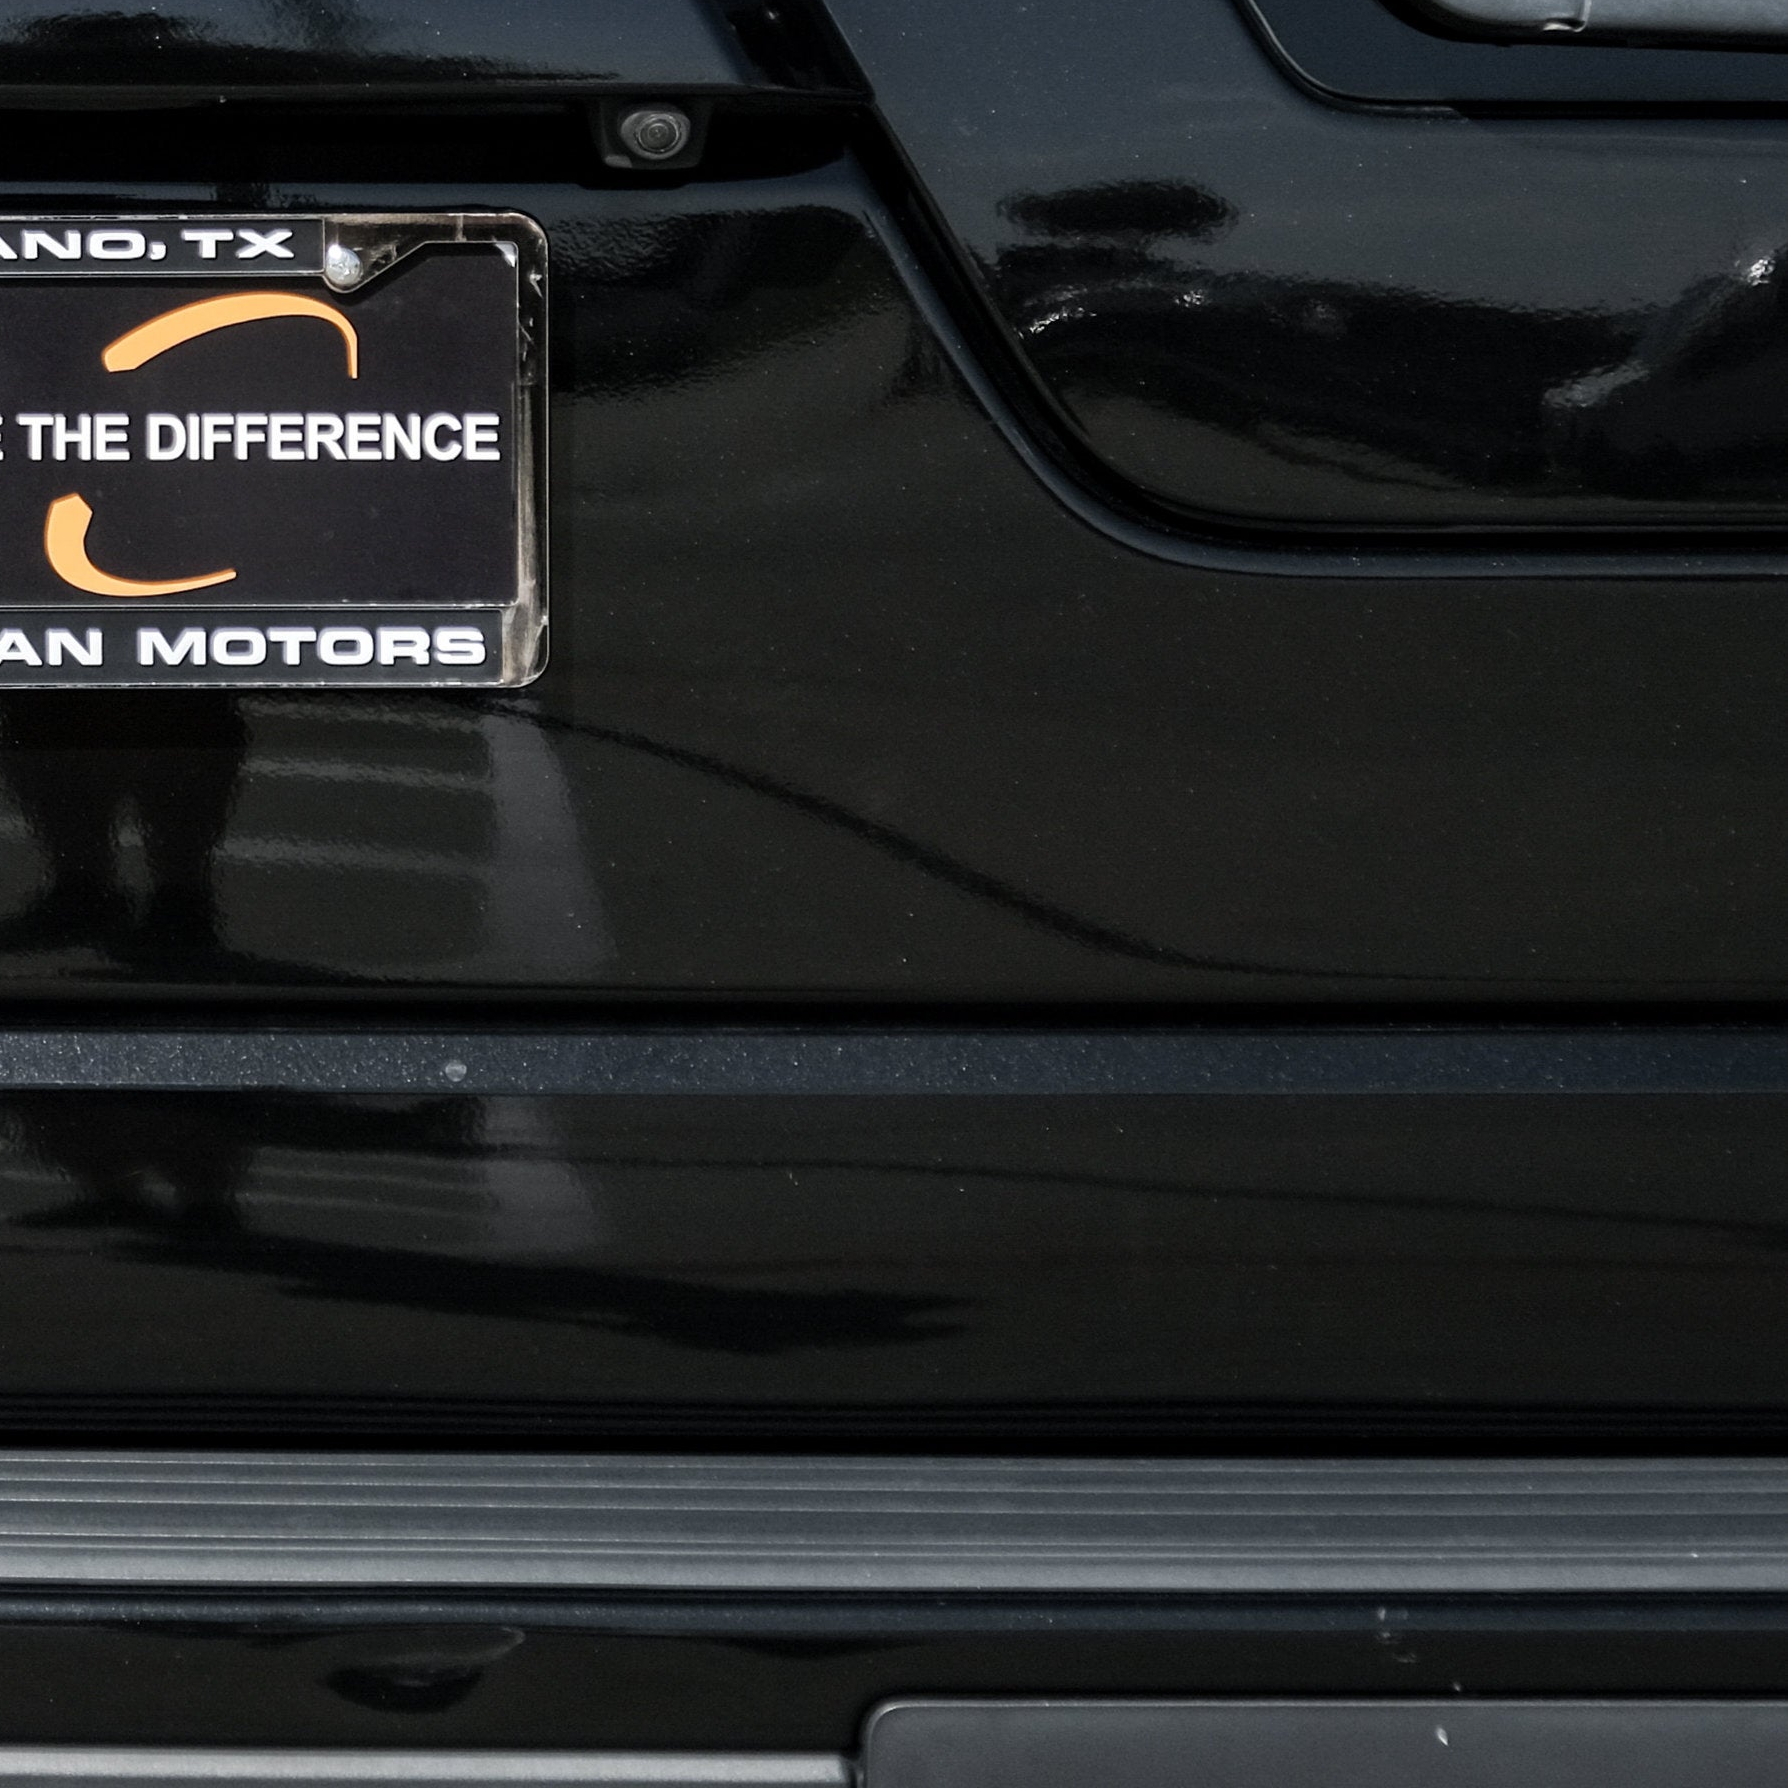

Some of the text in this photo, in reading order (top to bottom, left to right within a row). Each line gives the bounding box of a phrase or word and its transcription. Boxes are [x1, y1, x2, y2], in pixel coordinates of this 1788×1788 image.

[181, 228, 295, 259] TX
[15, 413, 131, 461] THE
[146, 412, 501, 462] DIFFERENCE
[136, 626, 486, 666] MOTORS
